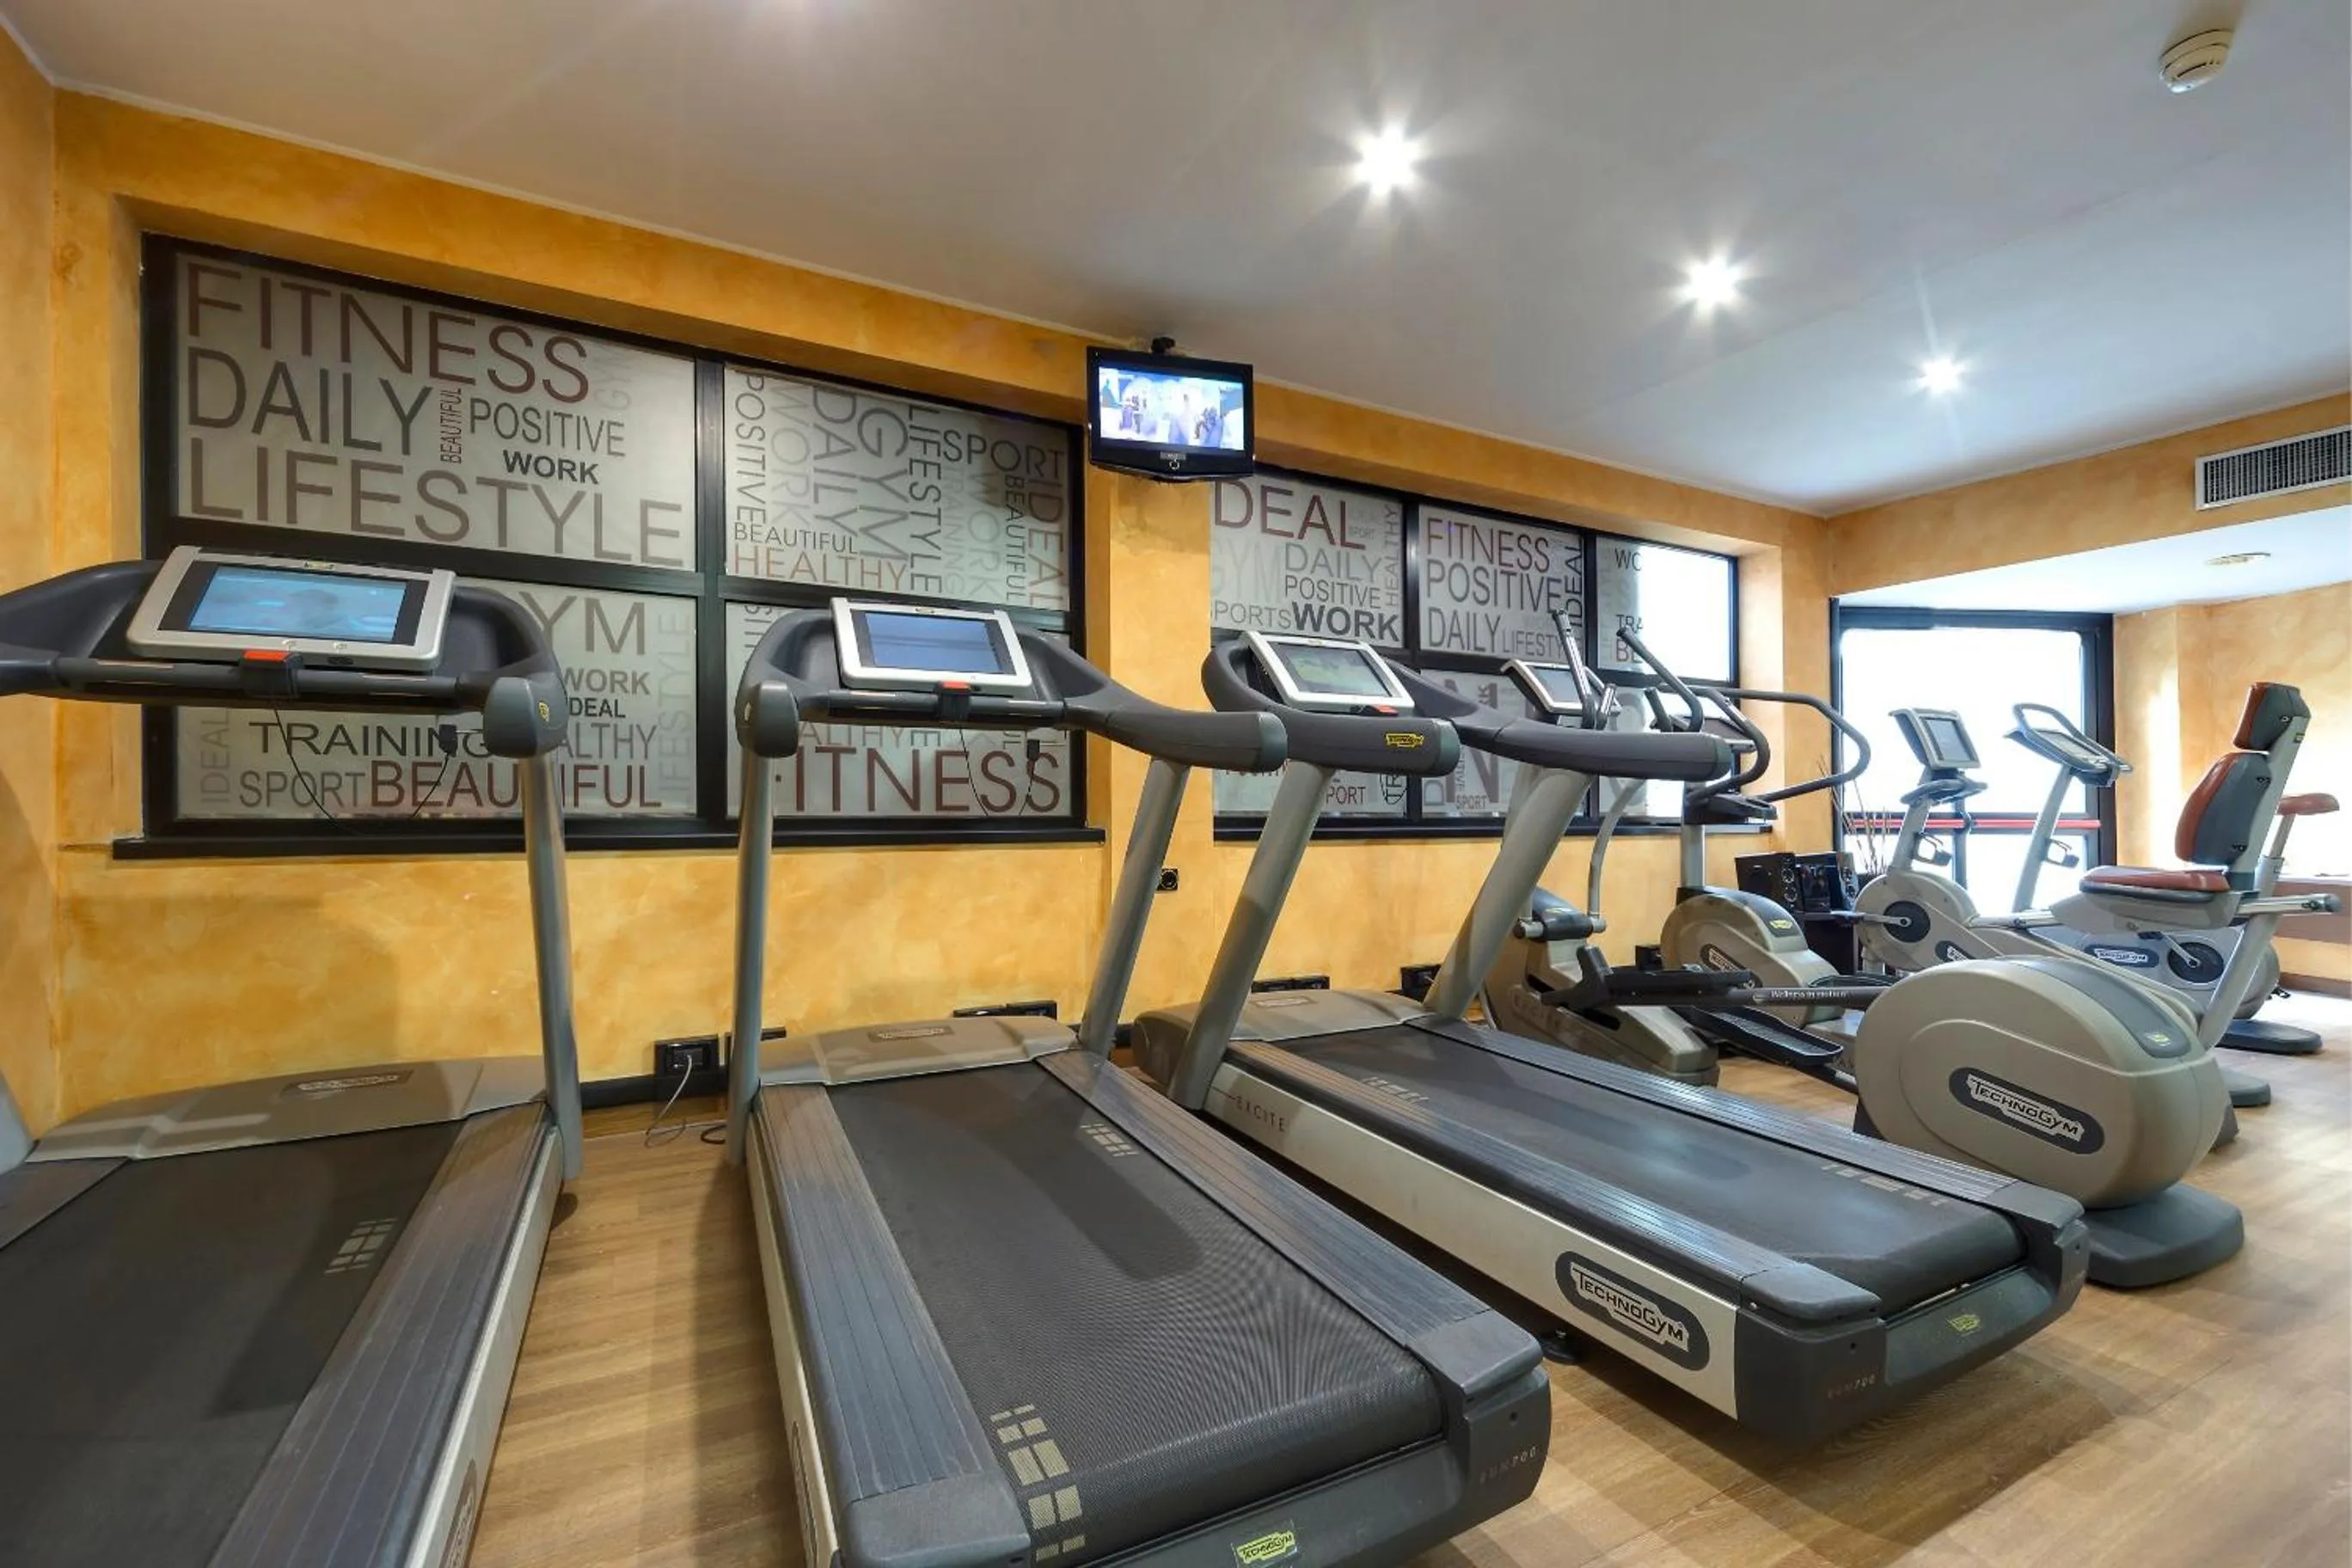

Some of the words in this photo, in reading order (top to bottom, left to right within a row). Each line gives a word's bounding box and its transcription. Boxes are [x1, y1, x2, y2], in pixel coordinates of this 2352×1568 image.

[187, 261, 590, 404] FITNESS
[187, 346, 433, 456] DAILY
[440, 387, 462, 463] BEAUTIFUL
[469, 397, 626, 458] POSITIVE
[503, 449, 600, 485] WORK
[735, 375, 768, 524] POSITIVE
[771, 384, 811, 529] WORK
[813, 384, 860, 538] DAILY
[943, 429, 1066, 479] SPORT
[190, 437, 684, 567] LIFESTYLE
[857, 407, 910, 561] GYM
[910, 404, 943, 593] LIFESTYLE
[1214, 478, 1366, 550] DEAL
[734, 521, 859, 554] BEAUTIFUL
[734, 543, 908, 591] HEALTHY
[1005, 475, 1027, 601] BEAUTIFUL
[1029, 479, 1064, 607] IDEAL
[1285, 542, 1381, 583] DAILY
[1383, 504, 1400, 608] HEALTHY
[1427, 518, 1551, 573] FITNESS
[1285, 575, 1381, 609] POSITIVE
[1427, 558, 1564, 614] POSITIVE
[1565, 545, 1583, 628] IDEAL
[519, 590, 646, 655] YM
[1212, 599, 1291, 629] PORTS
[1292, 601, 1400, 642] WORK
[1429, 607, 1502, 653] DAILY
[1503, 628, 1566, 658] LIFESTY
[563, 667, 651, 695] WORK
[567, 696, 626, 719] DEAL
[658, 609, 691, 798] IFESTYLE
[199, 708, 230, 804] IDEAL
[560, 719, 657, 760] ALTHY
[799, 721, 905, 749] ALTHY
[239, 769, 366, 807] SPORT
[371, 759, 663, 809] BEAUIFUL
[794, 744, 1061, 813] ITNESS
[1326, 786, 1366, 805] PORT
[1969, 1076, 2079, 1136] TECHNOGYM
[1571, 1265, 1684, 1343] TECHNOGYM
